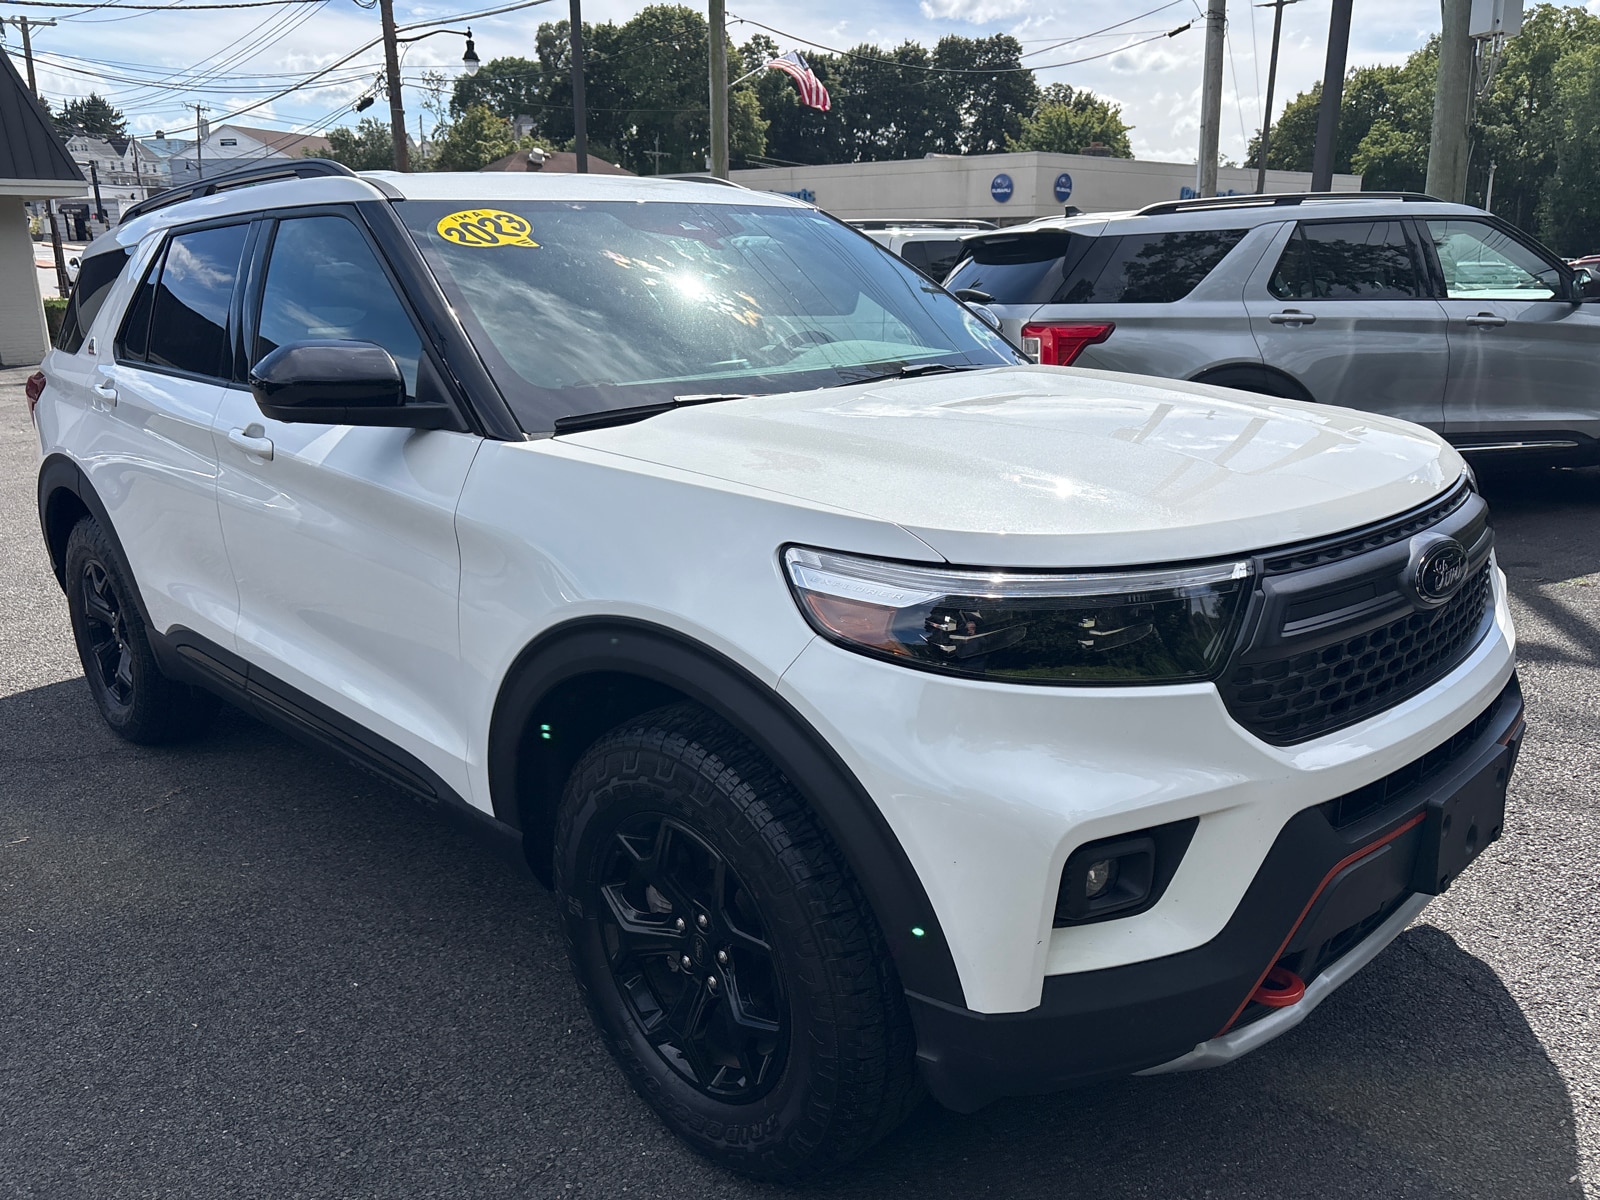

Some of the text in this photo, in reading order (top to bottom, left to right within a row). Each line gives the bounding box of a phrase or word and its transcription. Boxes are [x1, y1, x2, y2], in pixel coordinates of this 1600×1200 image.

[444, 214, 527, 244] 2023
[451, 213, 471, 222] I'M
[1433, 553, 1462, 591] Ford
[810, 576, 904, 600] EXPLORER
